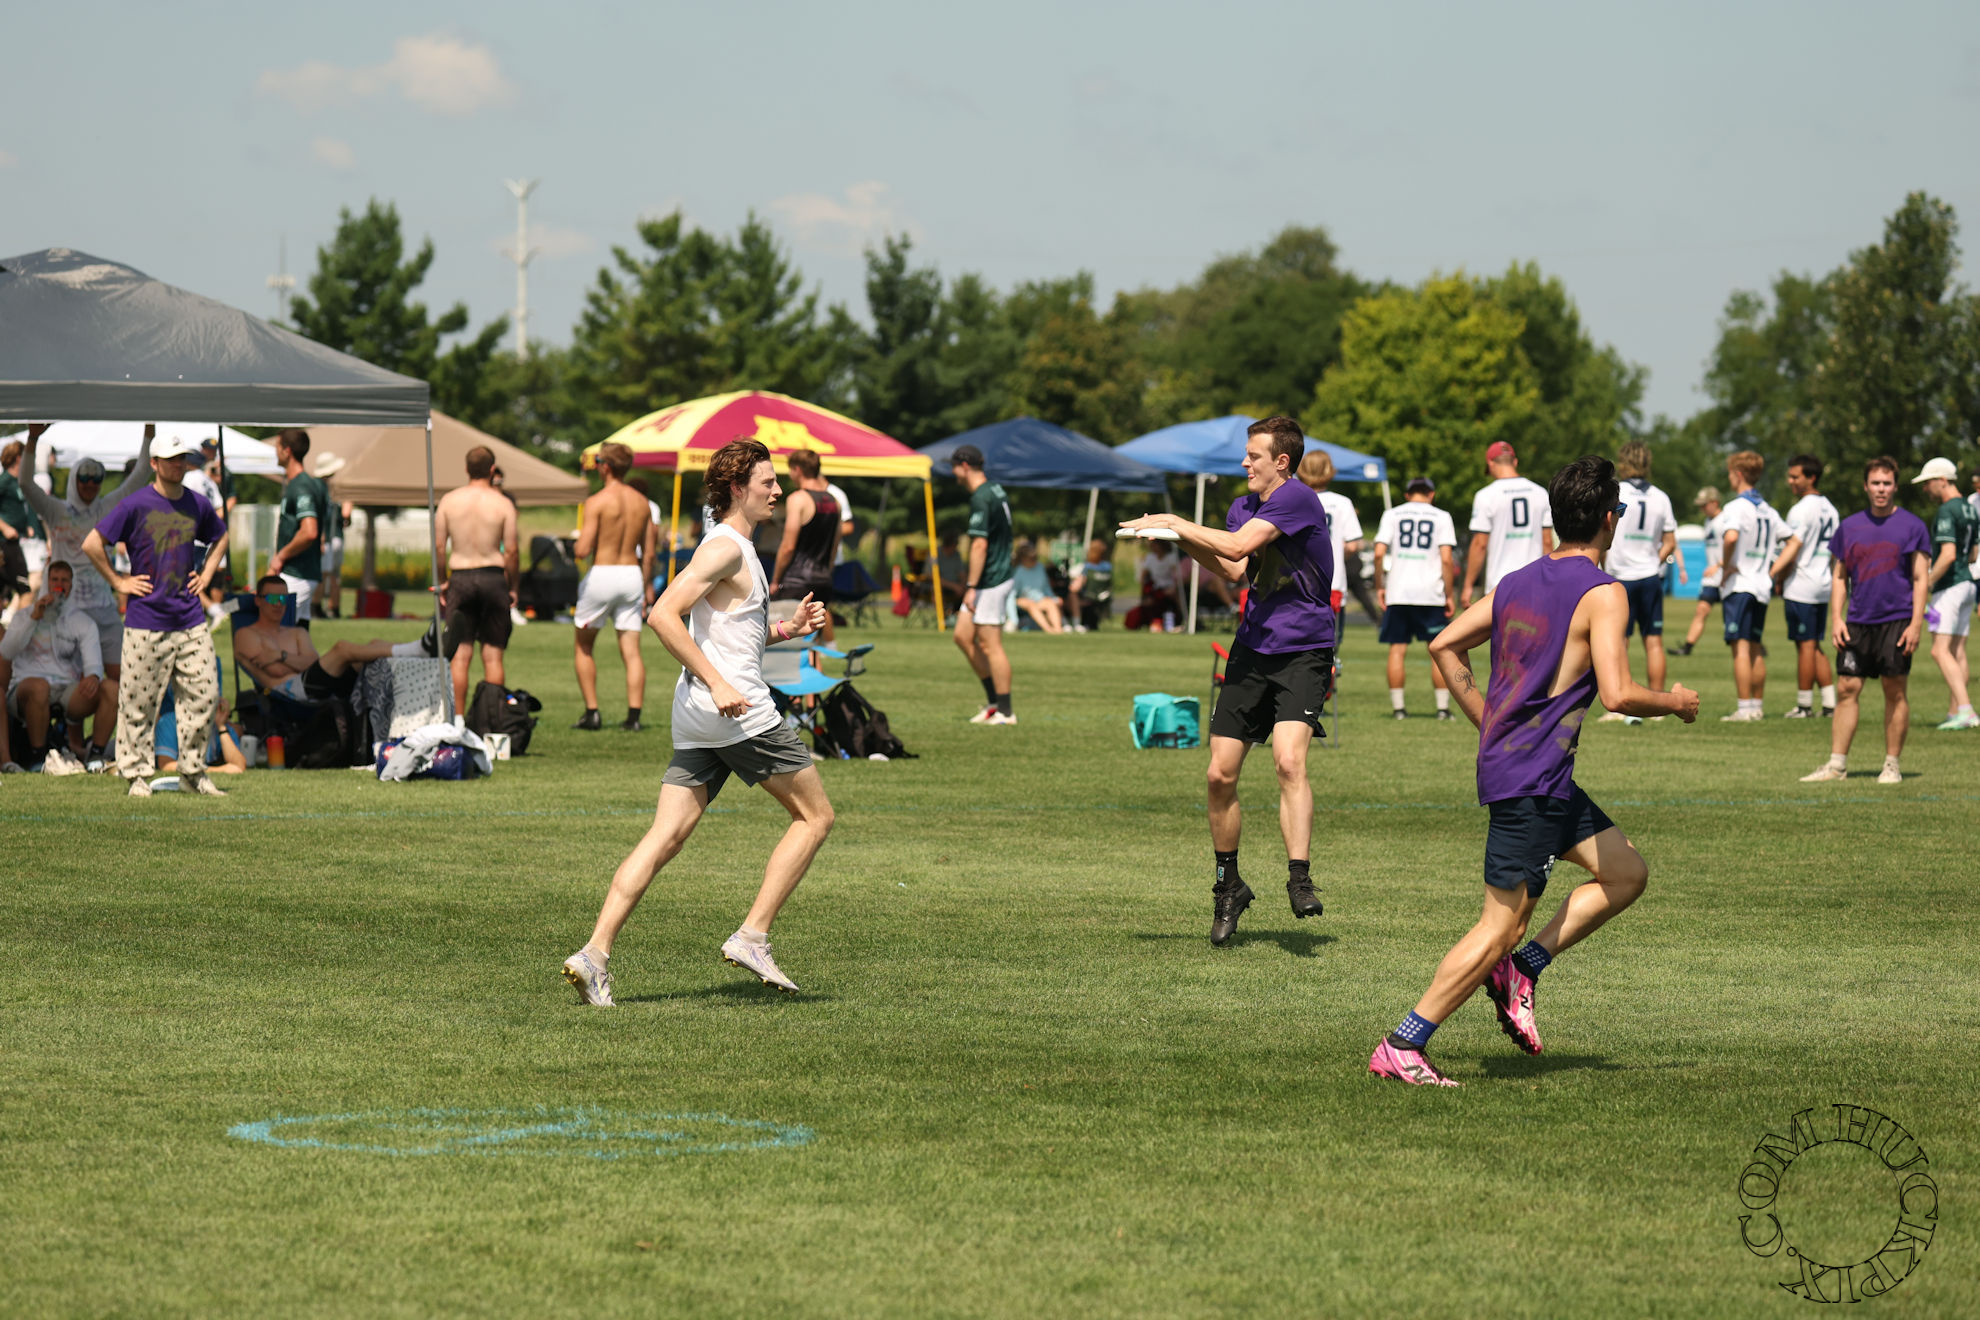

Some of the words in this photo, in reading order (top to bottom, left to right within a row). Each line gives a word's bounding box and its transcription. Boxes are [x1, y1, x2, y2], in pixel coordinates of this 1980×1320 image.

[1637, 500, 1646, 530] 1
[1399, 519, 1434, 549] 88
[1755, 518, 1770, 548] 11
